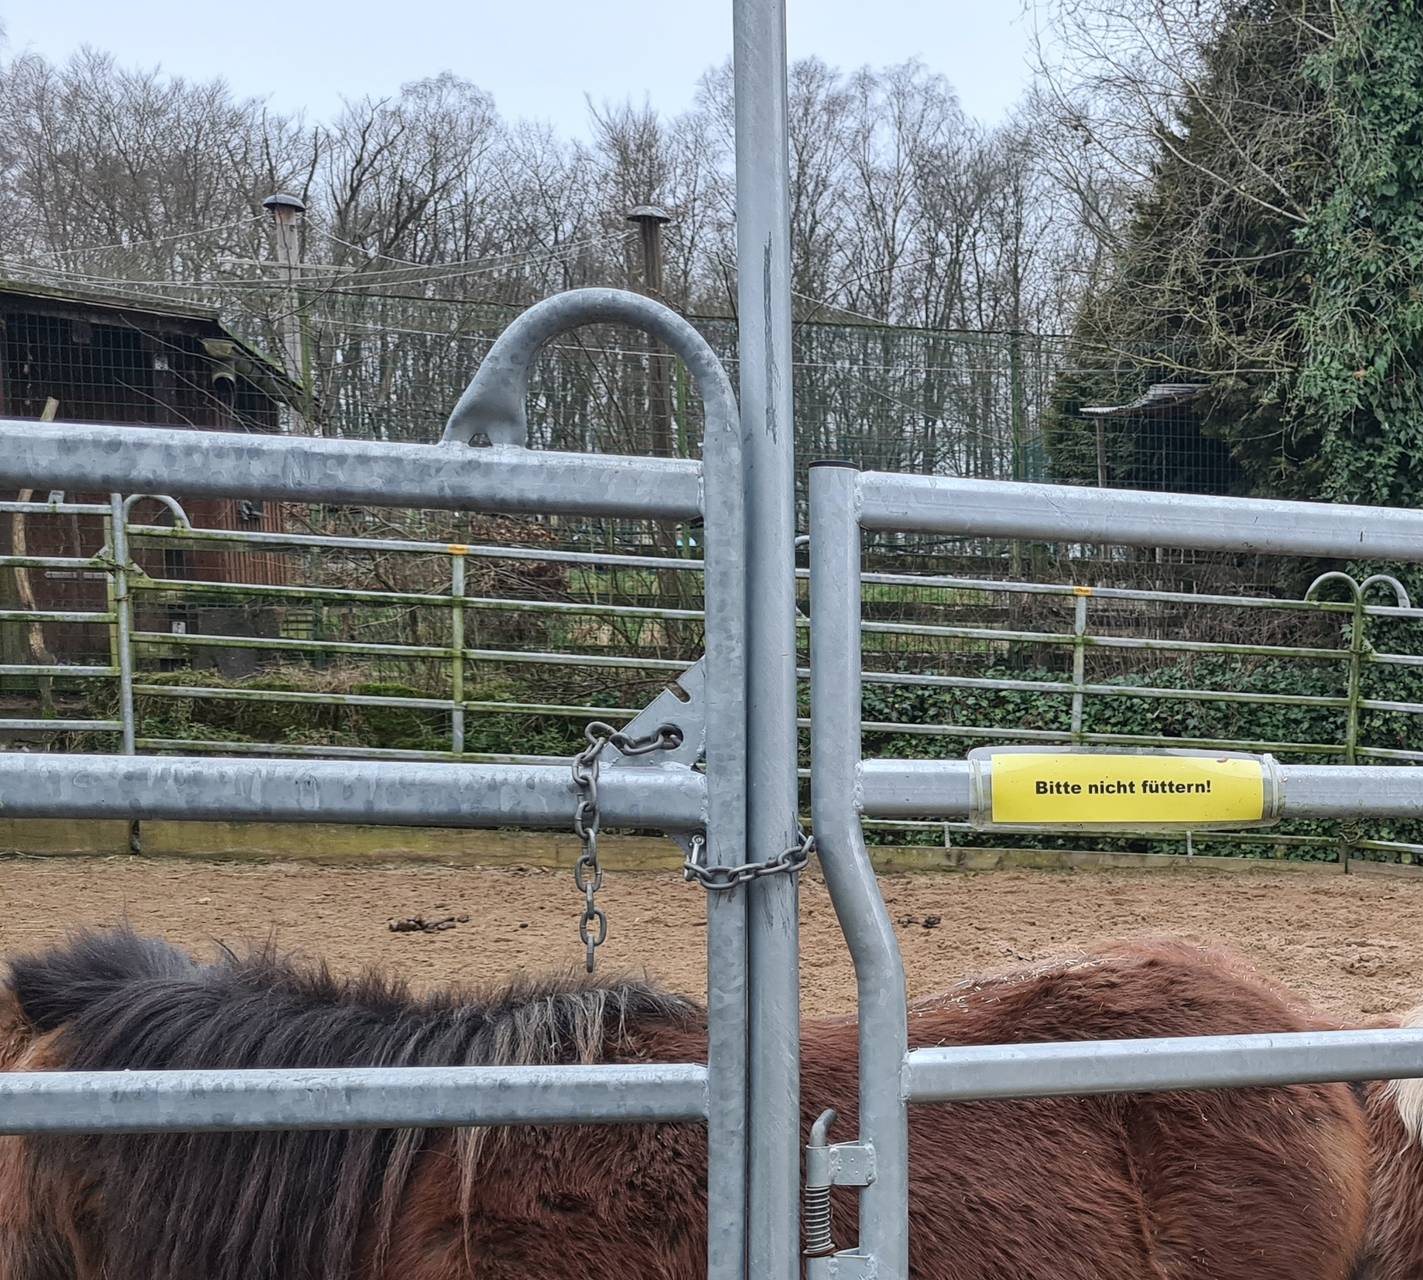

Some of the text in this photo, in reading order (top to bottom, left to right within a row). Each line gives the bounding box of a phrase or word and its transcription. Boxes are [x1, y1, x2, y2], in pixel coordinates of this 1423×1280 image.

[1035, 780, 1212, 795] Bitte nicht füttern!
